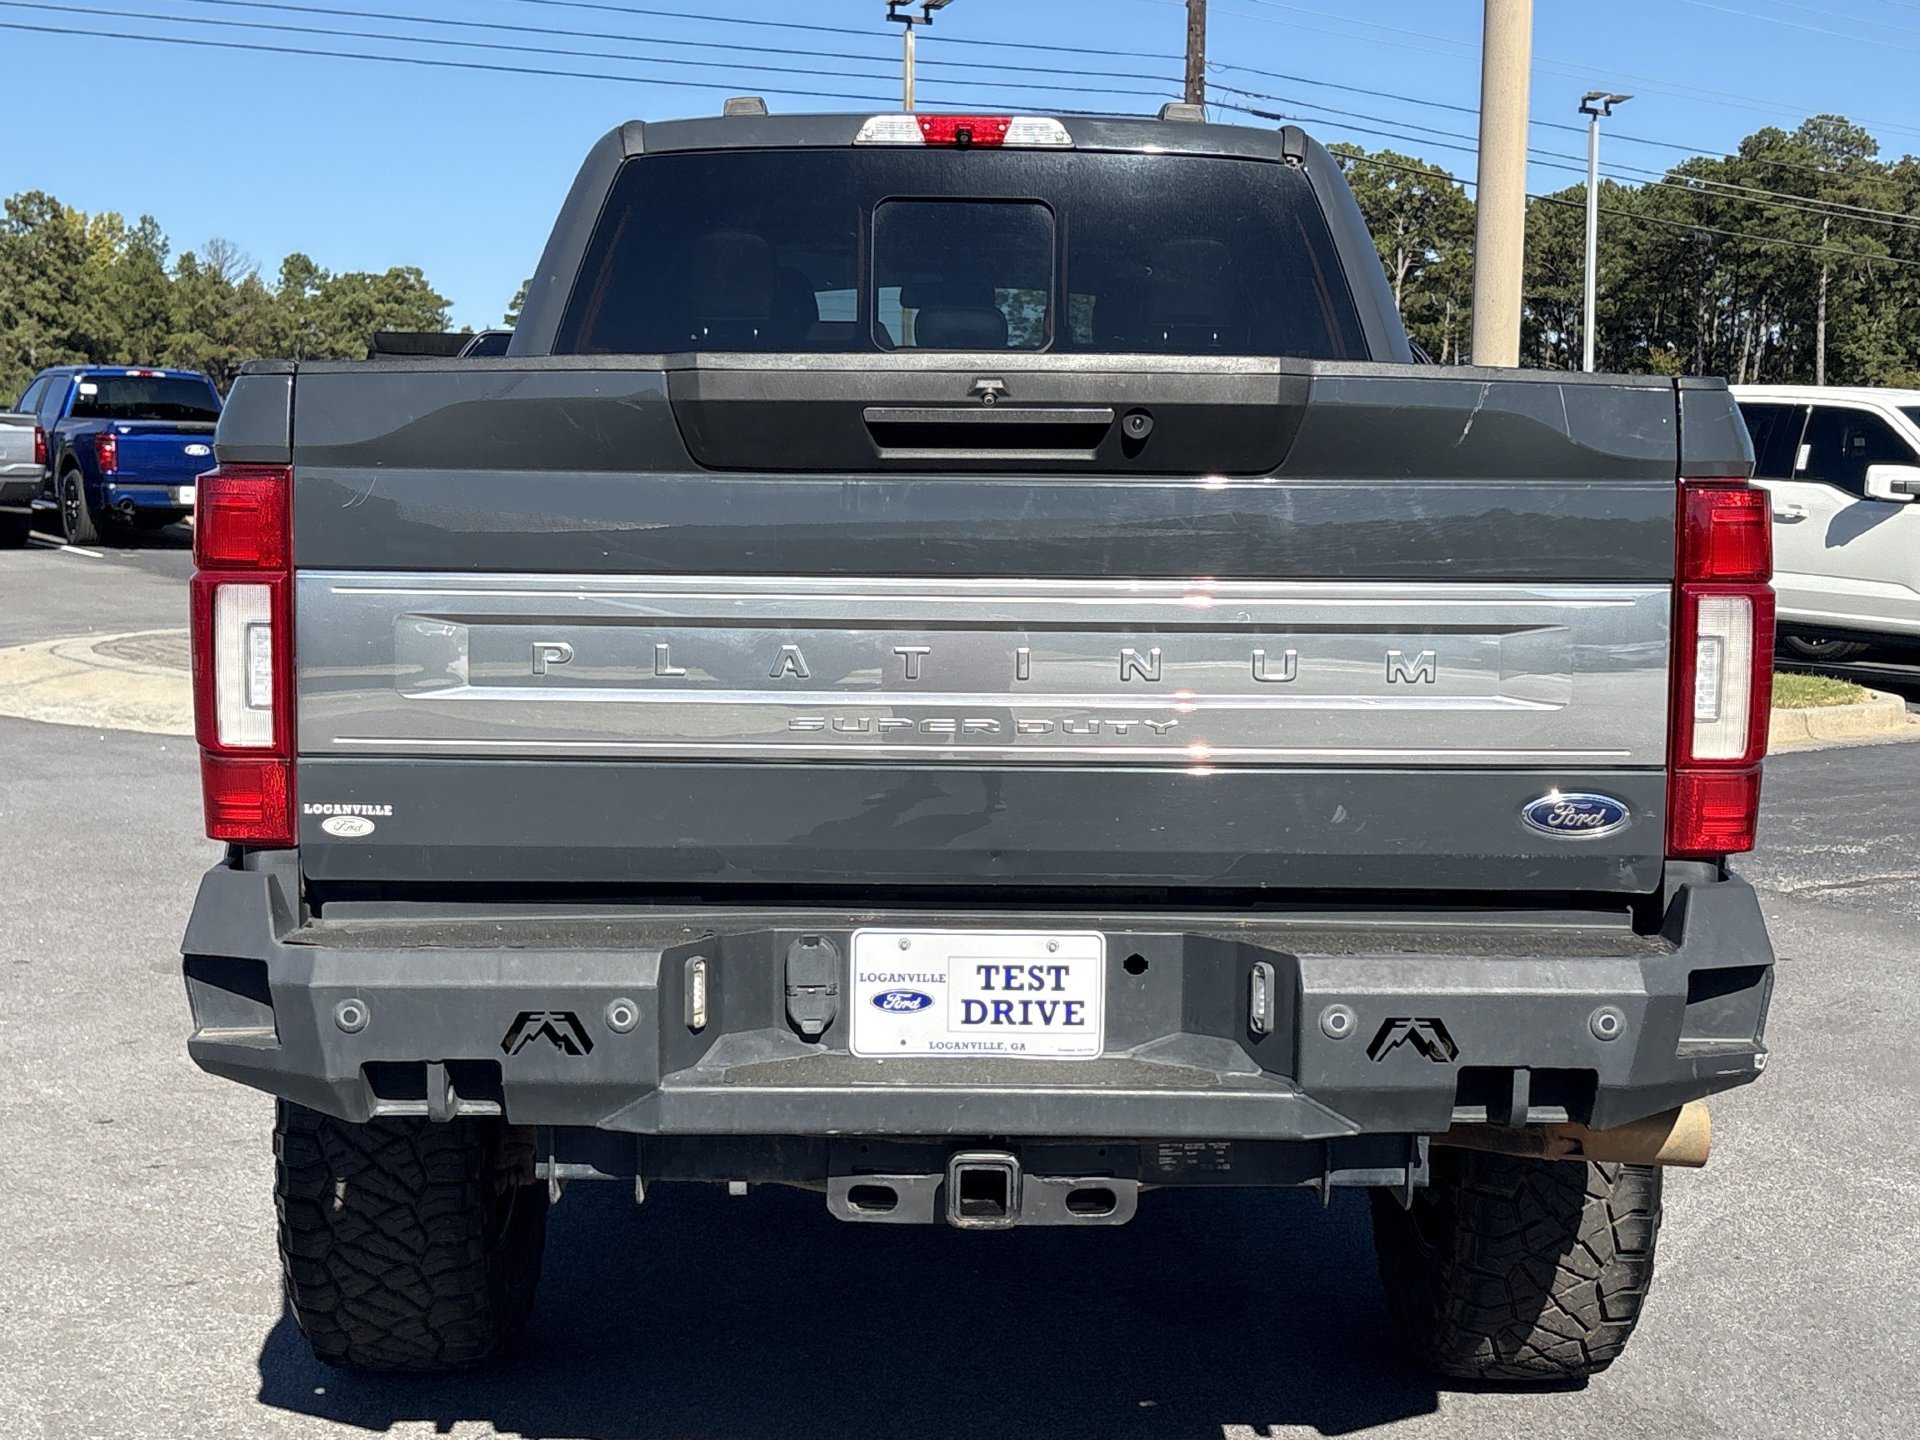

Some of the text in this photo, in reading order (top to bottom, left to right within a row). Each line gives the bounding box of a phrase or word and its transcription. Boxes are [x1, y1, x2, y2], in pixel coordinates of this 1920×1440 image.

[531, 641, 1437, 684] PLATINUM
[303, 803, 393, 816] LOGANVILLE
[1547, 801, 1606, 827] Ford
[859, 972, 947, 984] LOGANVILLE
[976, 964, 1070, 992] TEST
[882, 993, 922, 1011] Ford
[960, 998, 1085, 1026] DRIVE
[929, 1041, 1026, 1052] LOGANVILLE, GA
